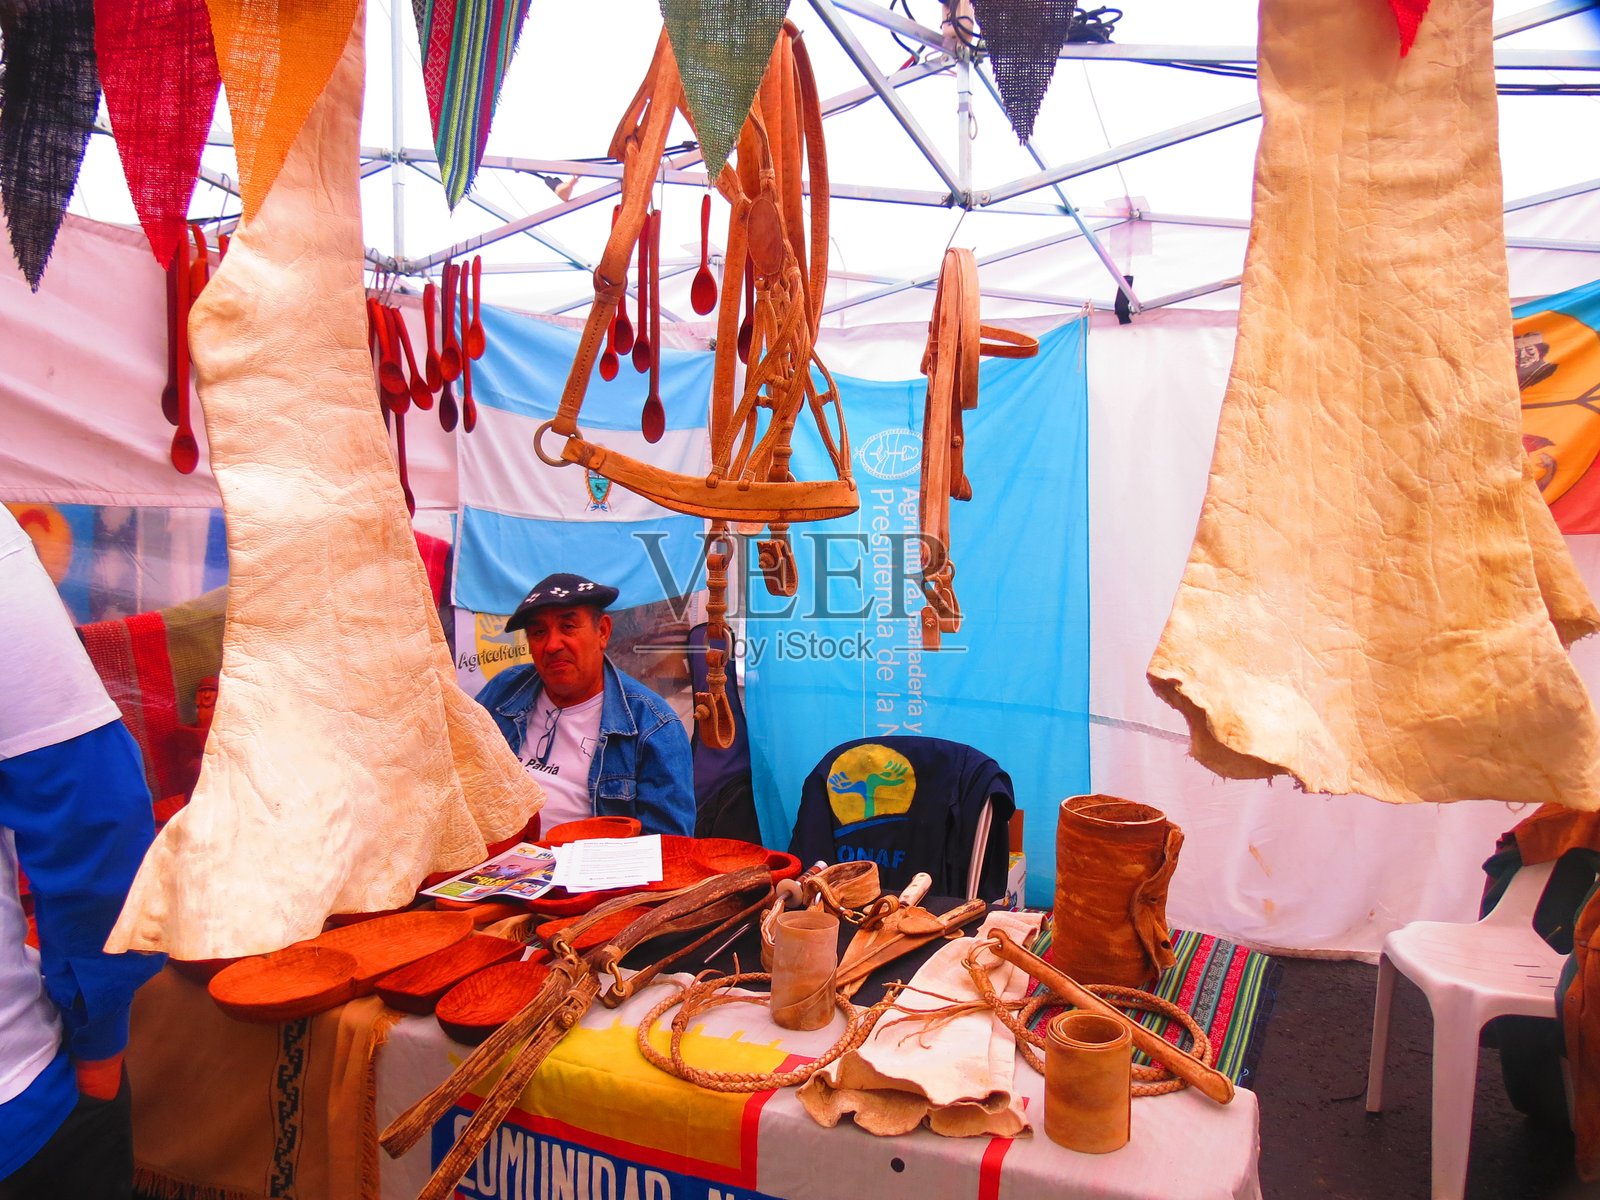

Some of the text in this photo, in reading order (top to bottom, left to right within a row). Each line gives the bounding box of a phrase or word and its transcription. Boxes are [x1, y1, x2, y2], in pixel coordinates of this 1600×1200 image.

[898, 487, 922, 605] Agriultura,
[871, 489, 900, 638] Presidencia
[876, 648, 901, 681] de
[876, 692, 901, 712] la
[903, 721, 923, 734] y
[525, 758, 560, 776] Patria
